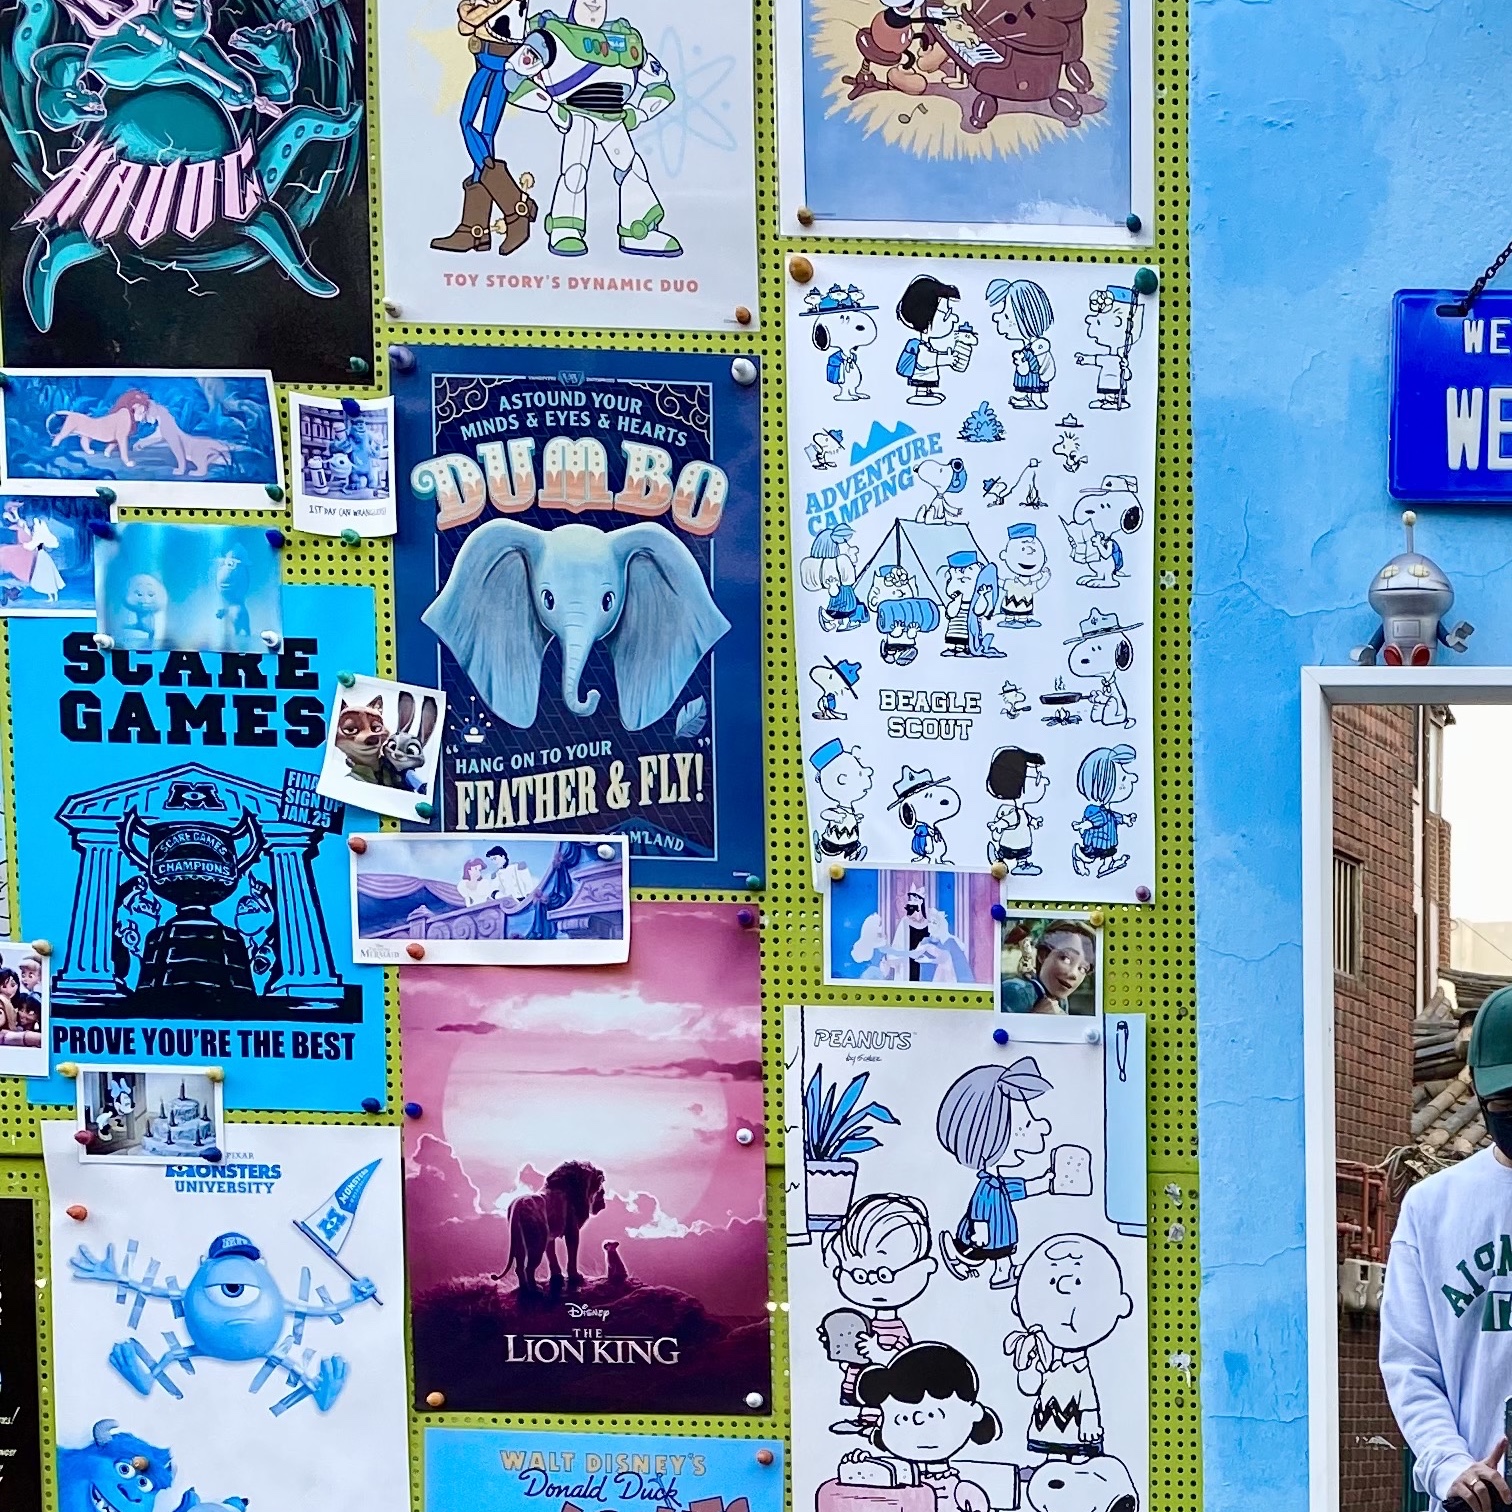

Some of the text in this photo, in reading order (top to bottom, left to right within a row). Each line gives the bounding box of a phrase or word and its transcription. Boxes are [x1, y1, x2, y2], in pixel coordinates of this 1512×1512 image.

[12, 129, 268, 249] HAVOC
[443, 273, 699, 293] TOY STORY'S DYNAMIC DUO
[1463, 318, 1512, 355] WE
[498, 390, 643, 415] ASTOUND YOUR
[460, 411, 689, 447] MINDS & EYES & HEARTS
[410, 435, 731, 536] DUMBO
[805, 432, 943, 515] ADVENTURE
[807, 466, 915, 538] CAMPING
[62, 631, 320, 691] SCARE
[879, 689, 982, 714] BEAGLE
[59, 690, 326, 748] GAMES
[887, 716, 974, 740] SCOUT
[456, 740, 612, 775] HANG ON TO YOUR
[287, 770, 319, 790] FINA
[455, 753, 704, 831] FEATHER & FLY!
[285, 787, 321, 808] SIGN
[161, 832, 227, 856] SCARE GAMES
[158, 861, 230, 876] CHAMPIONS
[52, 1025, 355, 1060] PROVE YOU'RE THE BEST
[814, 1029, 912, 1050] PEANUTS
[175, 1180, 275, 1194] UNIVERSITY
[565, 1302, 610, 1321] Disney
[572, 1328, 603, 1338] THE
[503, 1334, 681, 1364] LION KING
[500, 1450, 707, 1476] WALT DISNEY'S
[518, 1467, 683, 1507] Donald Duck
